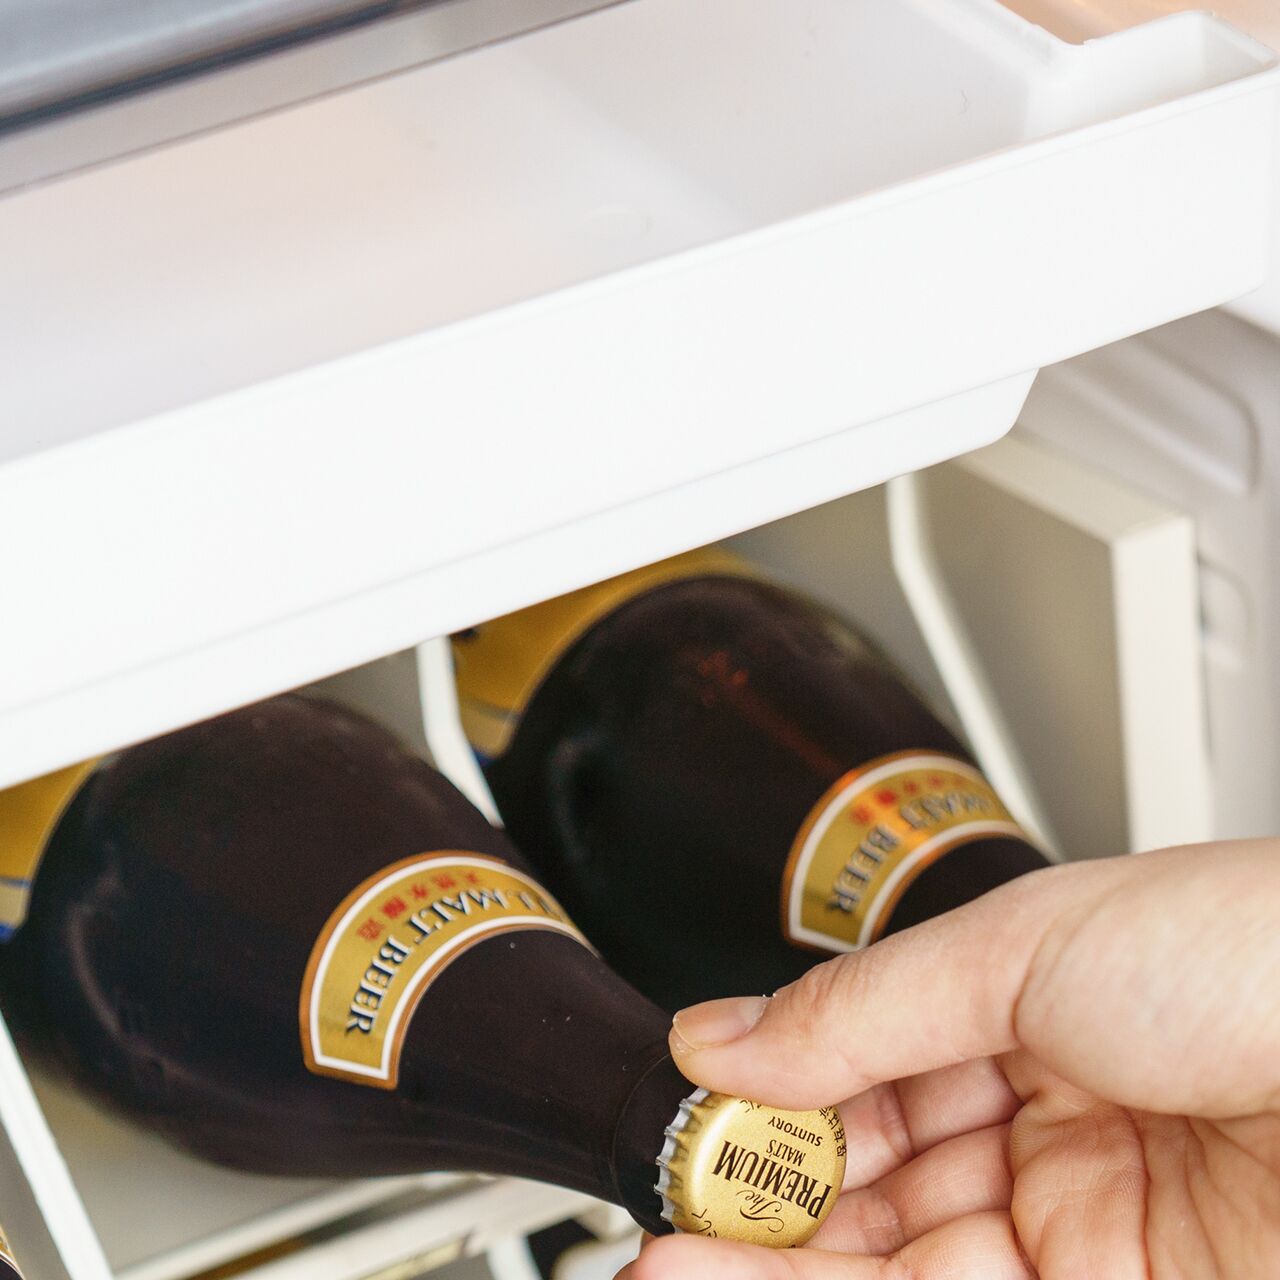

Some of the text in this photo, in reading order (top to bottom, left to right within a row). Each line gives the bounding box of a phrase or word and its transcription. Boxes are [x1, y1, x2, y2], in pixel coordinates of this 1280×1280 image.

[404, 888, 508, 945] MALT
[344, 935, 411, 1038] BEER
[766, 1138, 807, 1167] MALT'S
[767, 1115, 823, 1147] SUNTORY
[712, 1140, 833, 1220] PREMIUM
[736, 1189, 784, 1233] The
